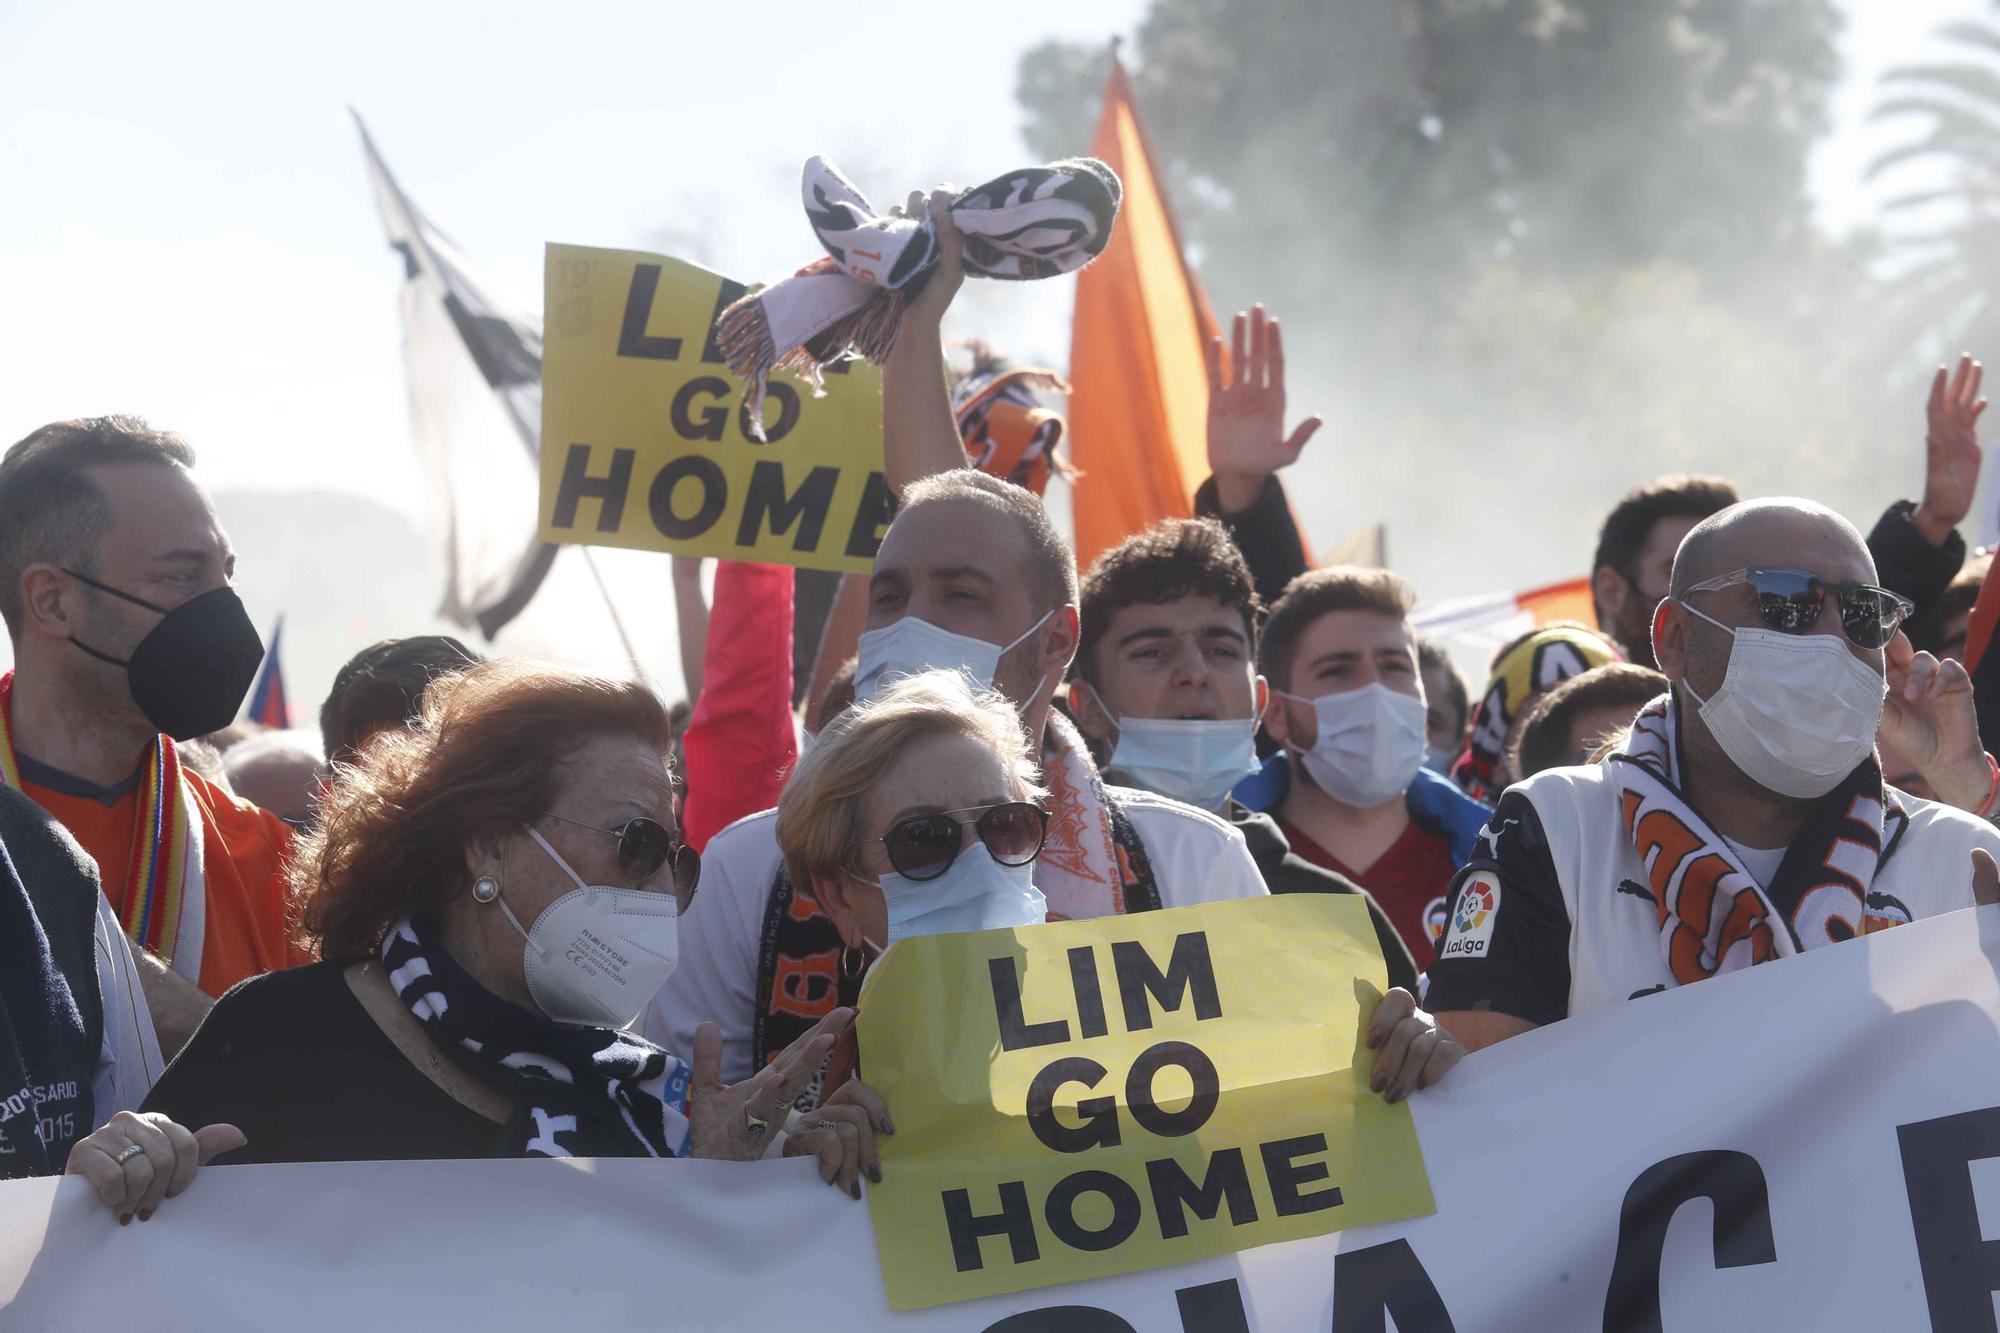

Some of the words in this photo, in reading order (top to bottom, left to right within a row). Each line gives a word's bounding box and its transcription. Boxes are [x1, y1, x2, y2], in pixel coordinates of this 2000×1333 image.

[670, 376, 801, 445] GO
[988, 931, 1223, 1052] LIM
[1446, 936, 1485, 954] LaLiga
[1025, 1040, 1220, 1154] GO
[941, 1132, 1344, 1272] HOME
